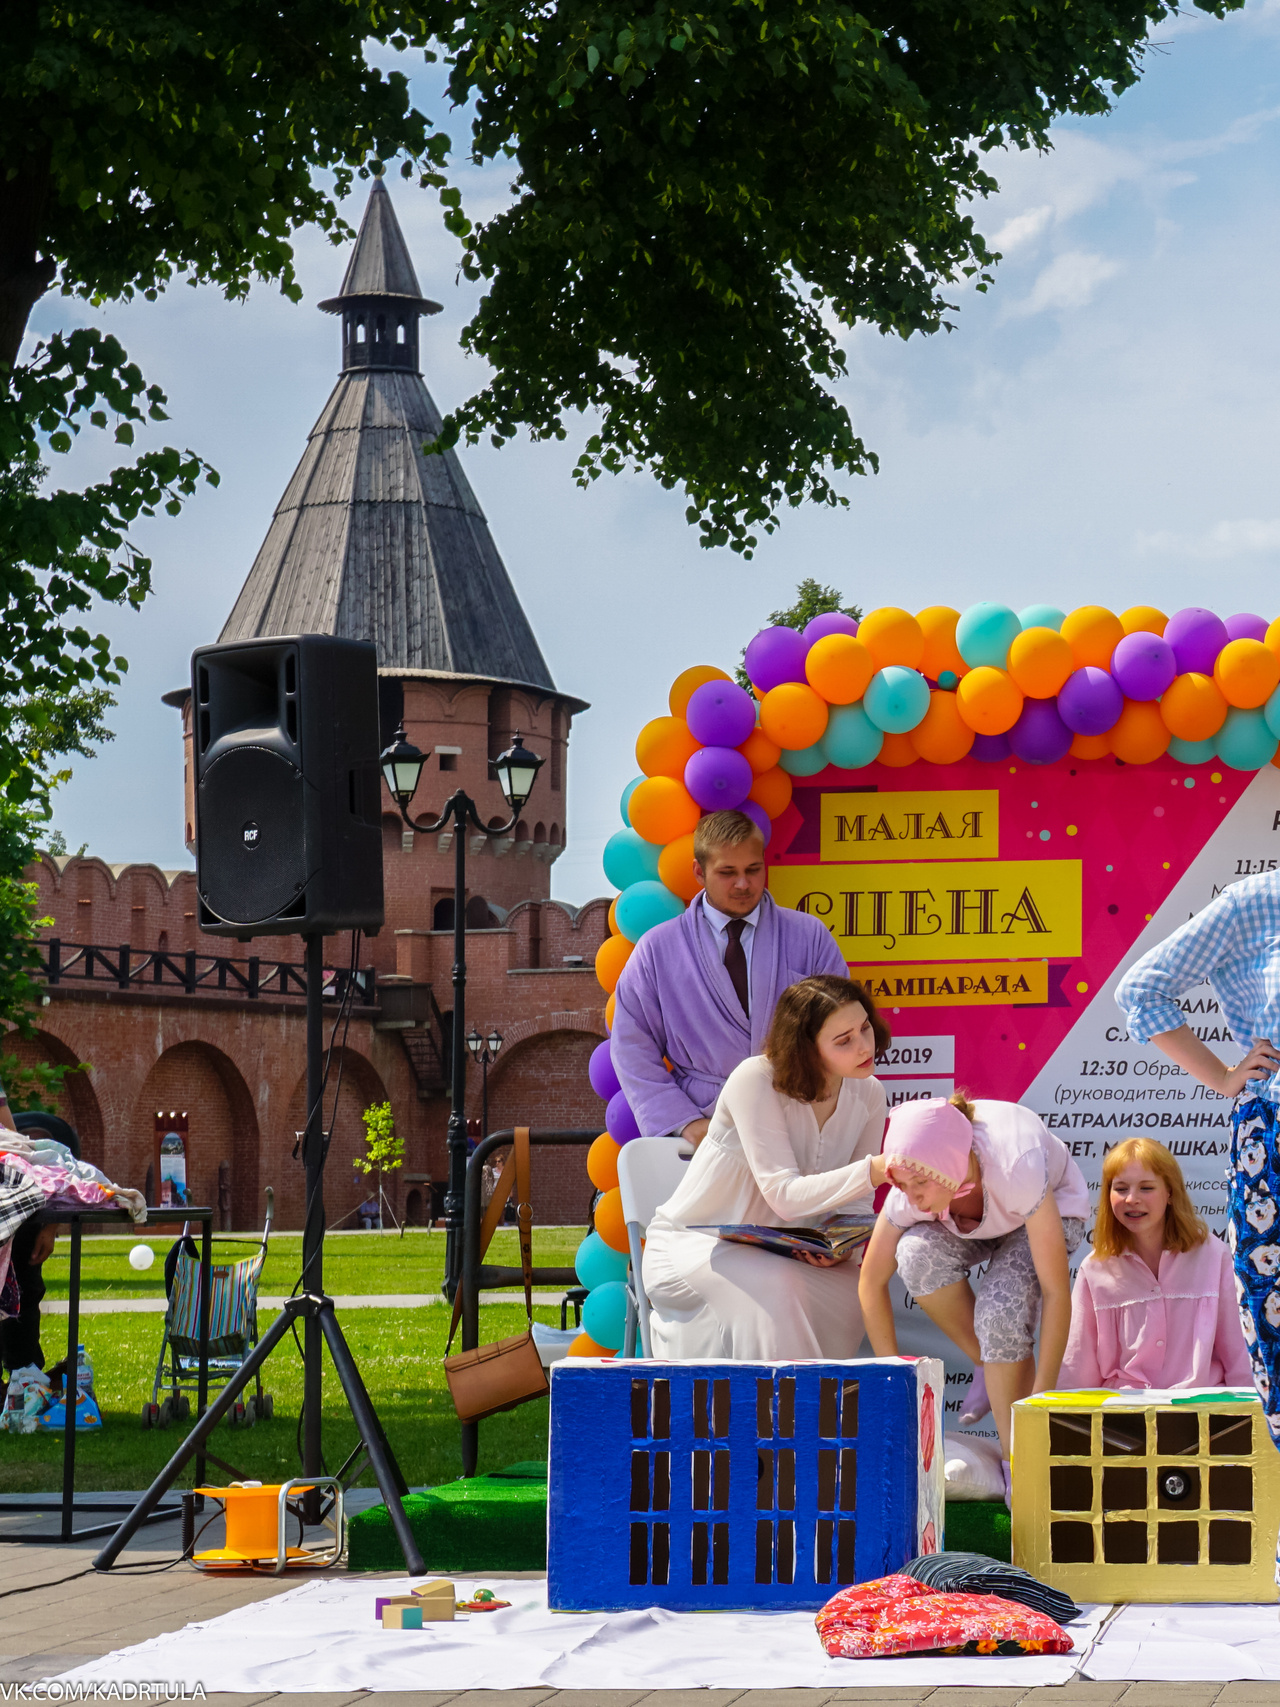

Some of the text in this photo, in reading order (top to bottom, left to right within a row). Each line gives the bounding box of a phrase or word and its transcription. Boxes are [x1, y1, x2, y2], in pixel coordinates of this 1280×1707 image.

[244, 829, 258, 841] RCF
[834, 811, 984, 842] МАЛАЯ
[795, 886, 1053, 950] СЦЕНА
[874, 1047, 933, 1066] Д2019
[1080, 1060, 1128, 1076] 12:30
[1055, 1083, 1187, 1105] (руководитель
